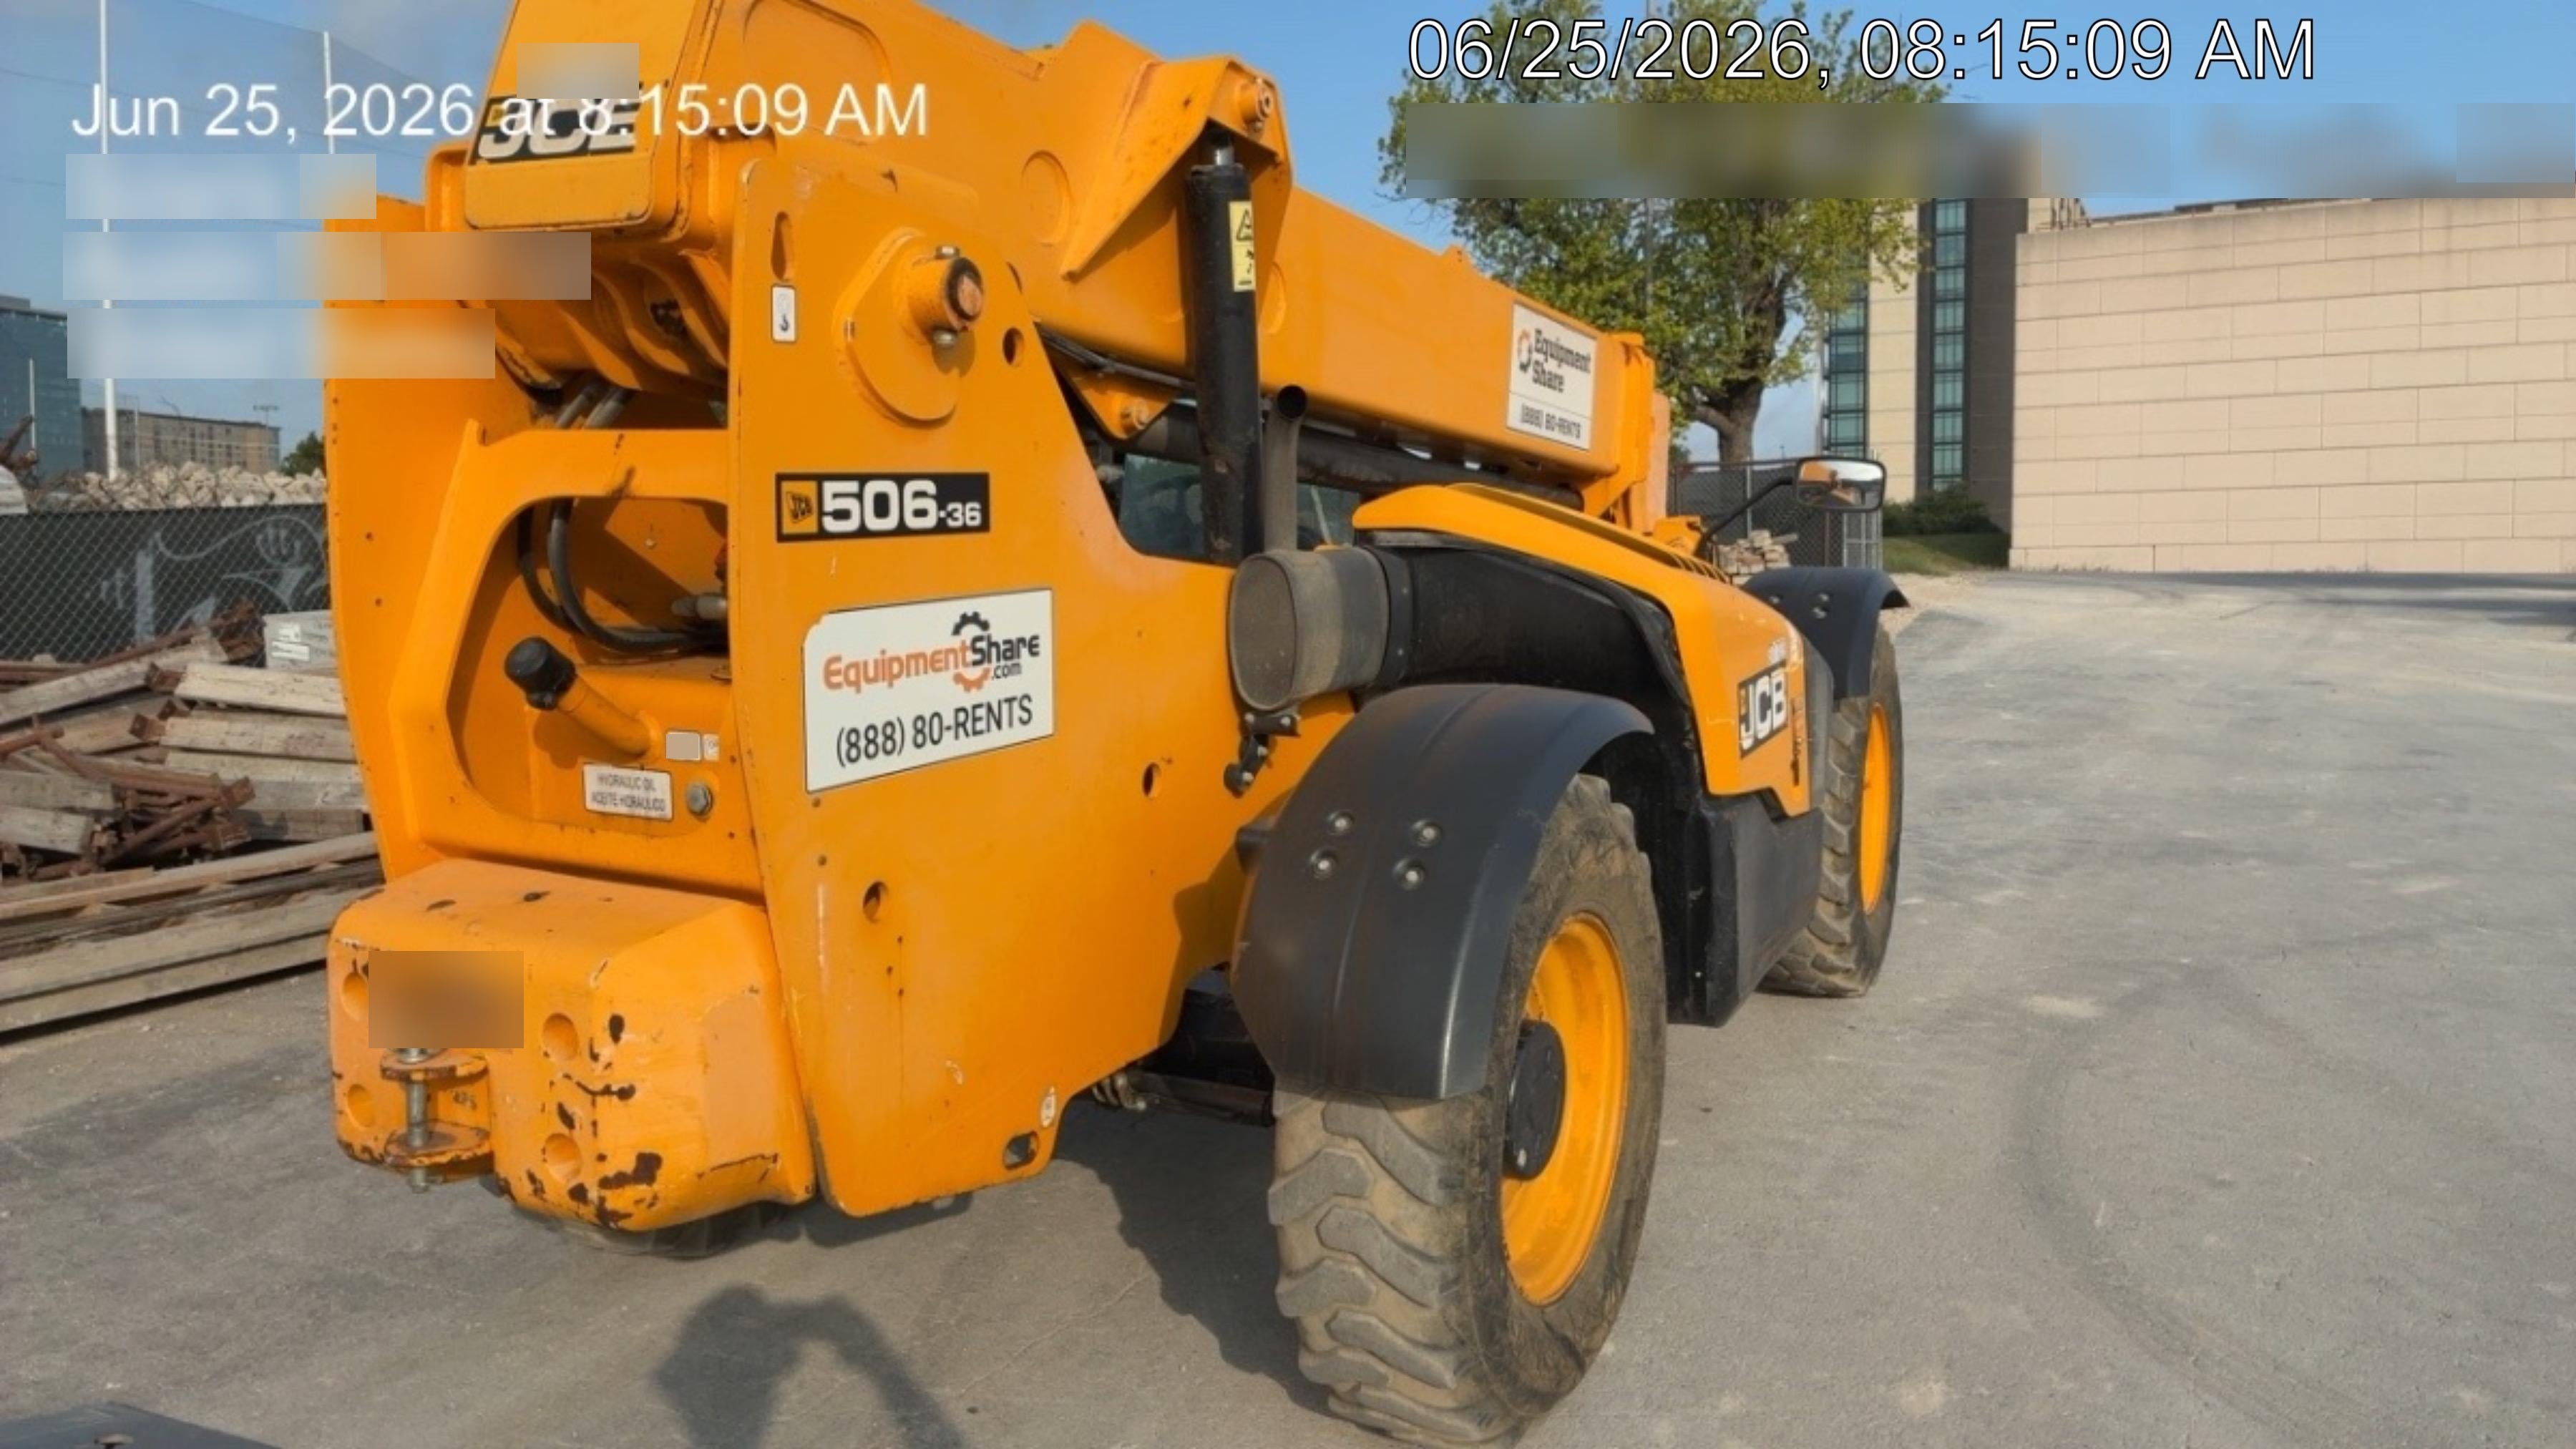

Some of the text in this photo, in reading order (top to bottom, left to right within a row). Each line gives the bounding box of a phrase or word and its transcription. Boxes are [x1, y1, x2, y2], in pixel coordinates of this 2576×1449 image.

[1531, 359, 1564, 393] Share
[1534, 328, 1591, 374] Equipment
[824, 633, 1040, 694] EquipmentShare
[992, 661, 1023, 680] .com
[836, 693, 1033, 769] (888) 80-RENTS
[1740, 666, 1788, 751] JCB
